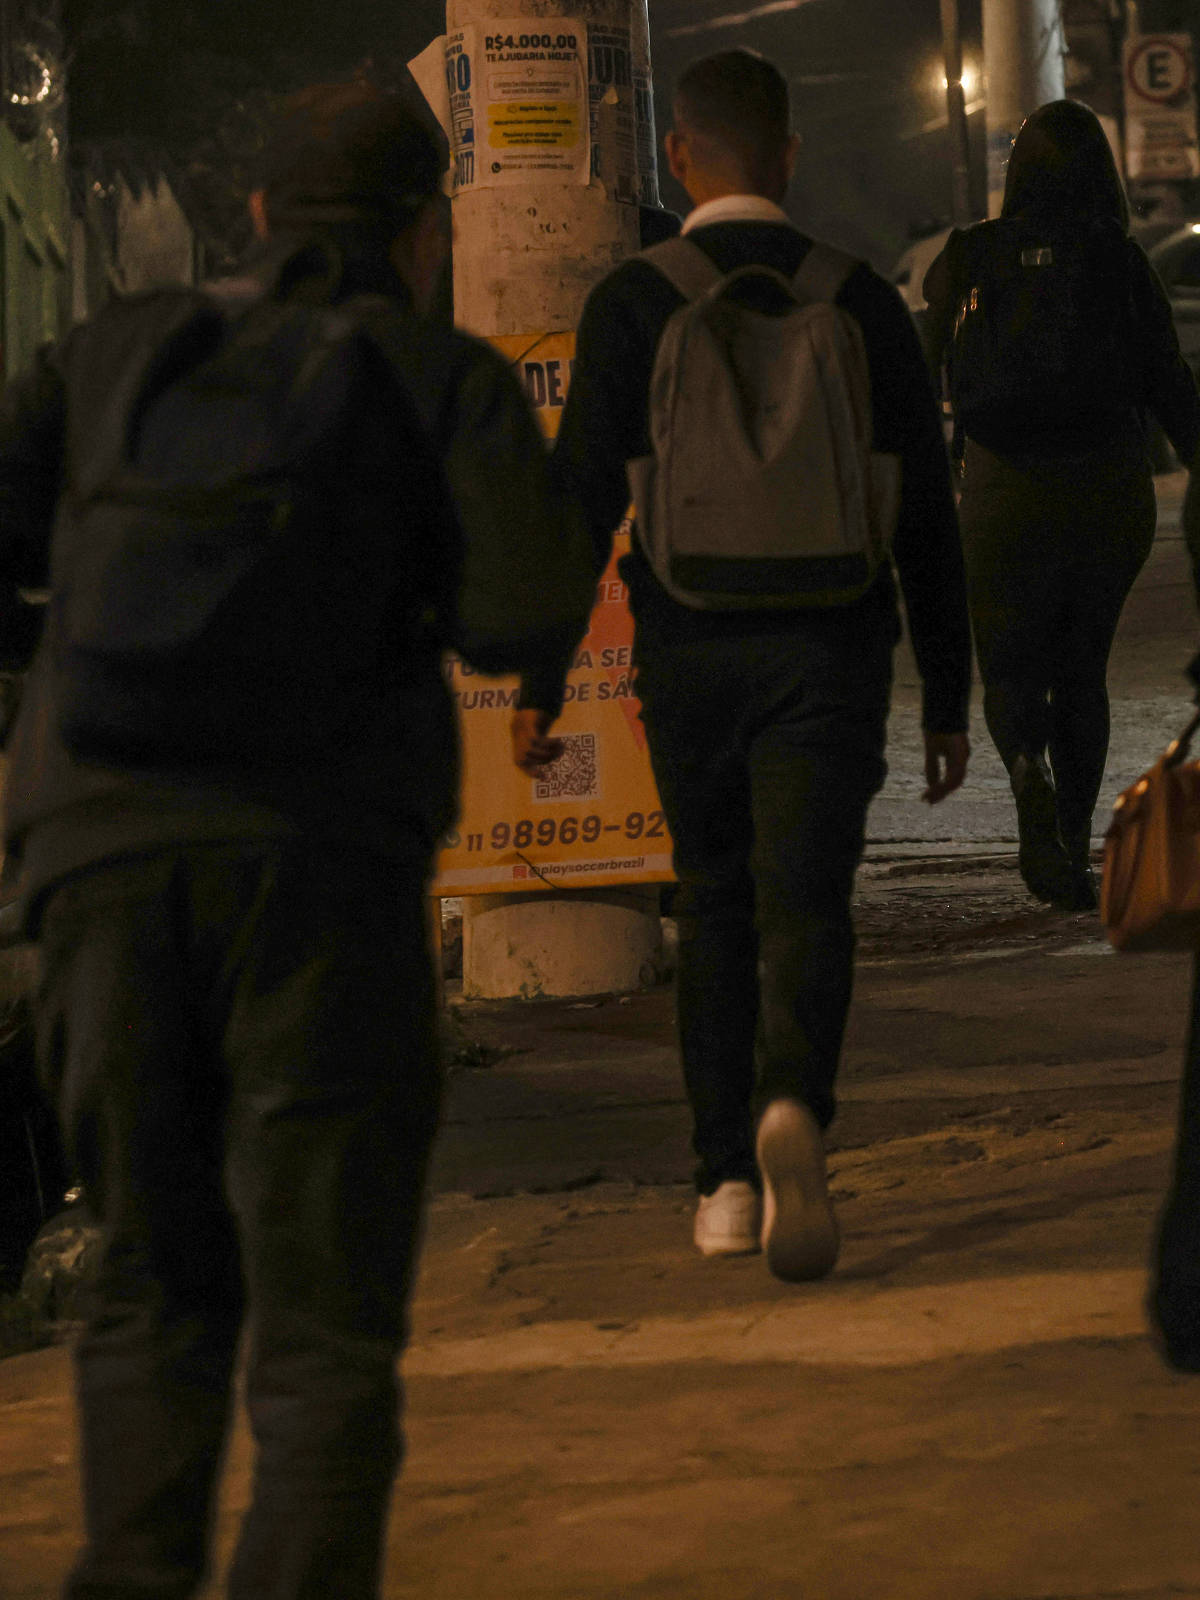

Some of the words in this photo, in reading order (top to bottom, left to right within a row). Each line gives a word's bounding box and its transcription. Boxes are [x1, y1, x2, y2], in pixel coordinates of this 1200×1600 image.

[485, 34, 577, 50] R$4.000,00
[487, 54, 496, 62] TE
[498, 52, 545, 61] AJUDARIA
[548, 52, 577, 60] HOJE?
[1147, 52, 1171, 88] E
[524, 360, 565, 406] DE
[600, 647, 633, 668] SE
[455, 689, 521, 710] URM
[561, 682, 590, 702] DE
[597, 672, 636, 700] SÁ
[467, 833, 484, 851] 11
[491, 811, 664, 850] 98969-92
[528, 857, 645, 878] @playsoccerbrazil
